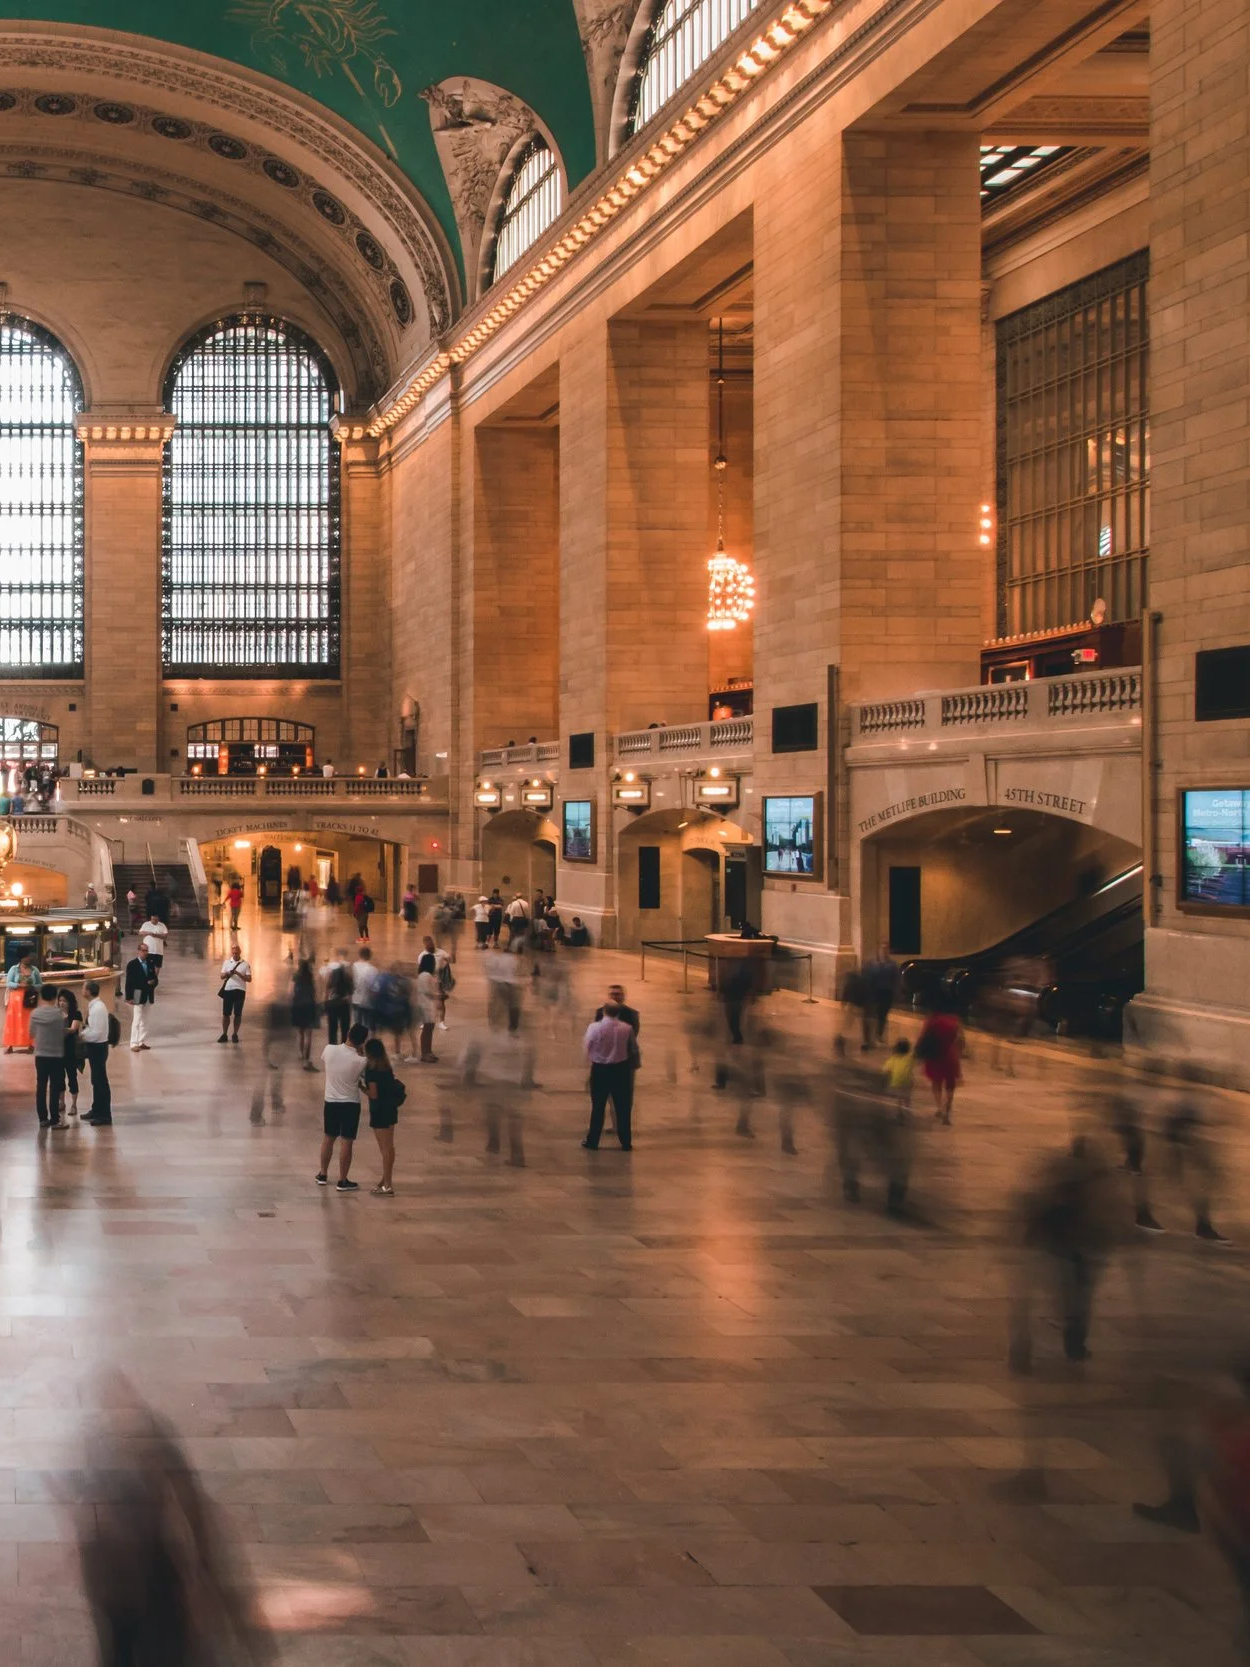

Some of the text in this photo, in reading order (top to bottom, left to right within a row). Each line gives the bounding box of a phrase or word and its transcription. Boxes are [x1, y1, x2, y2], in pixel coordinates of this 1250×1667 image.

[858, 788, 966, 832] THE METLIFE BUILDING
[1004, 788, 1086, 814] 45TH STREET
[215, 821, 288, 837] TICKET MACHINES
[317, 821, 347, 830] TRACKS
